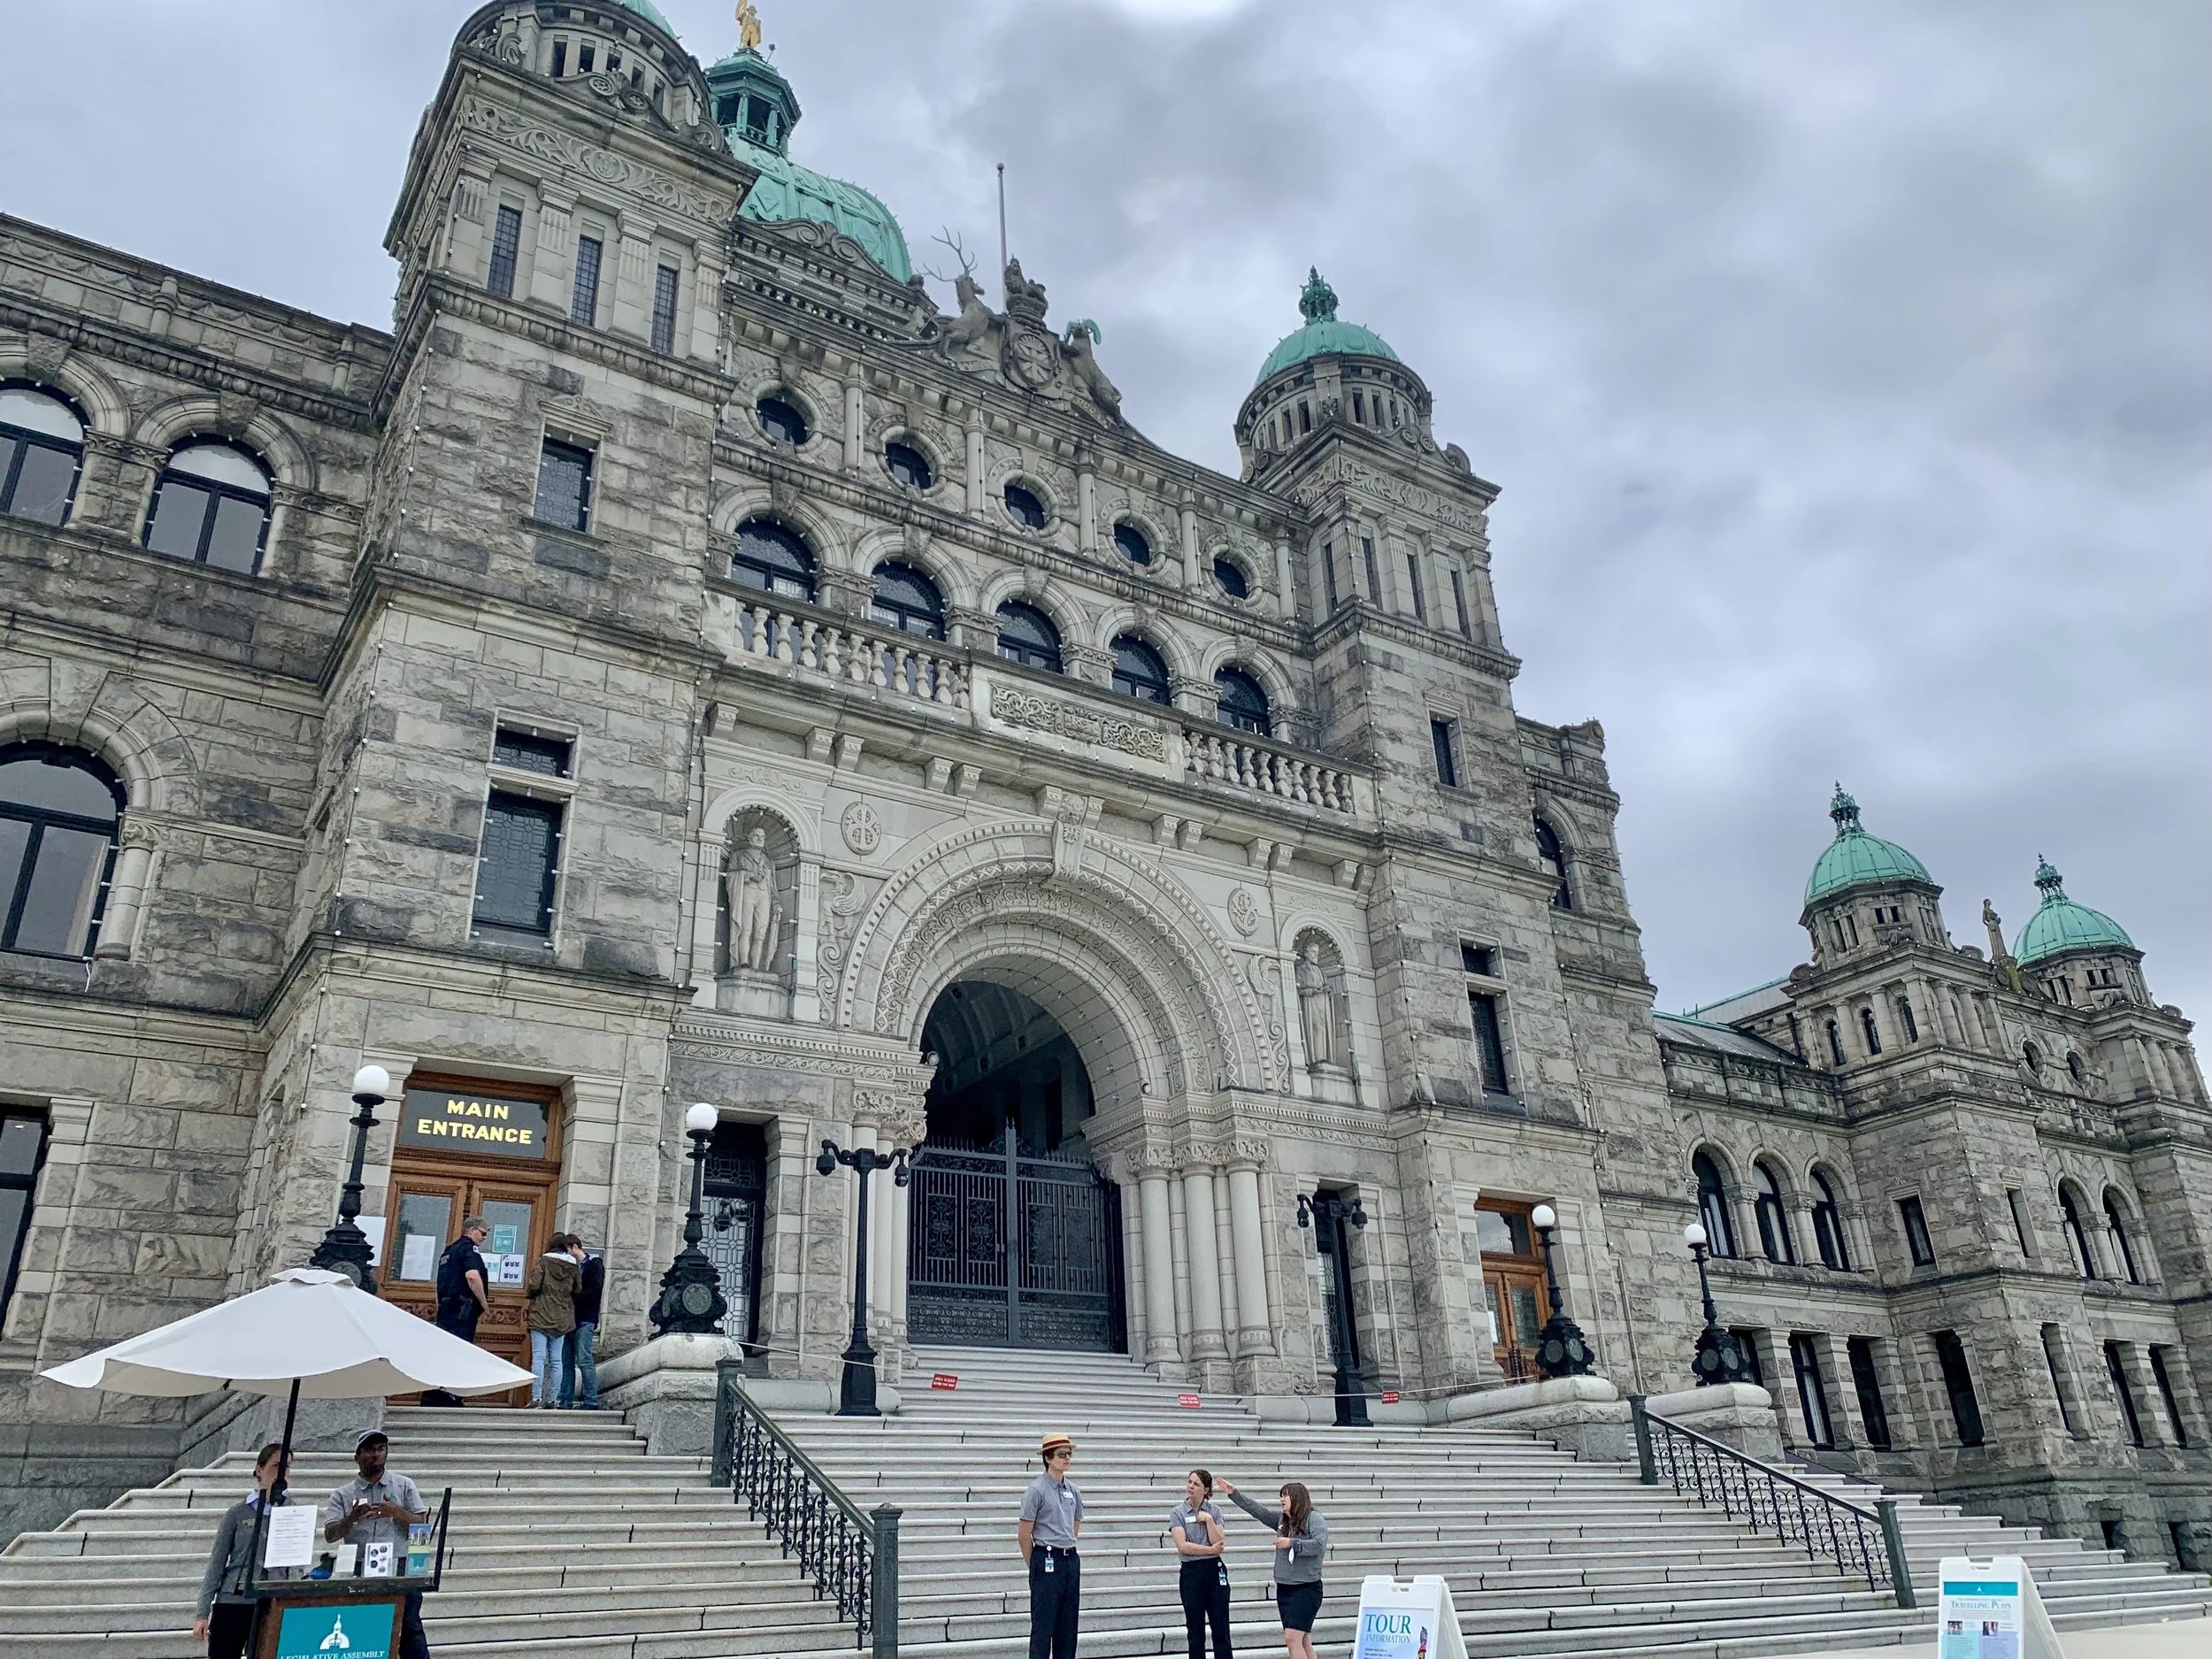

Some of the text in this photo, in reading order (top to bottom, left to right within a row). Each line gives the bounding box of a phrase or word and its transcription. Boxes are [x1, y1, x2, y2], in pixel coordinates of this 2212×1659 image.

[448, 1099, 509, 1120] MAIN
[417, 1118, 533, 1145] ENTRANCE
[1365, 1613, 1411, 1634] TOUR
[1365, 1633, 1410, 1643] INFORMATION
